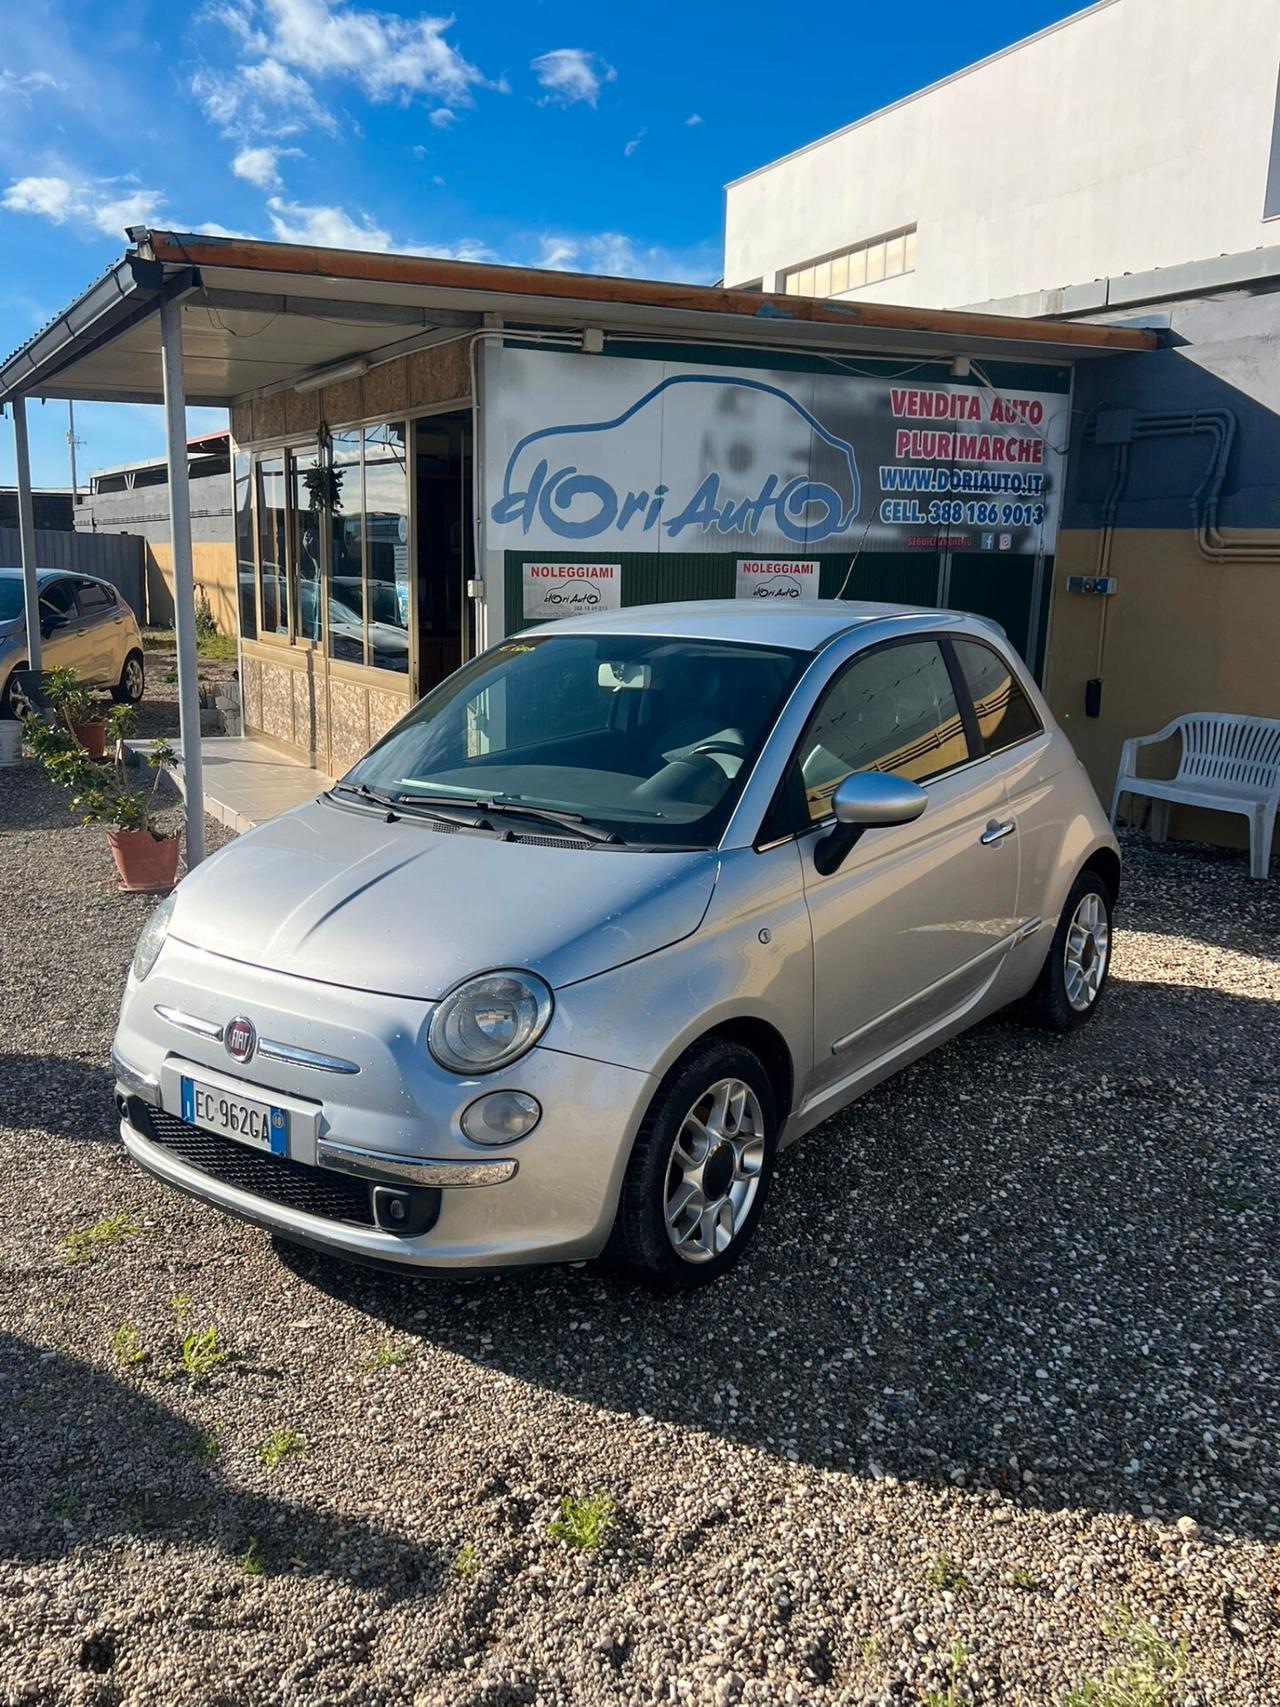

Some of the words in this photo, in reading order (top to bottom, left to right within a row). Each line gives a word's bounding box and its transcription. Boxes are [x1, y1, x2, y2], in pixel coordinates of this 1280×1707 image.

[891, 389, 981, 421] VENDITA
[990, 398, 1043, 425] AUTO
[897, 430, 1043, 463] PLURIMARCHE
[880, 466, 1043, 495] WWW.DORIAUTO.IT
[880, 501, 926, 523] CELL.
[930, 502, 962, 524] 388
[967, 504, 998, 524] 186
[1002, 504, 1045, 526] 9013
[531, 567, 614, 578] NOLEGGIAMI
[743, 563, 813, 574] NOLEGGIAMI
[231, 1029, 250, 1050] FIAT
[195, 1090, 214, 1122] EC
[219, 1099, 270, 1142] 962GA
